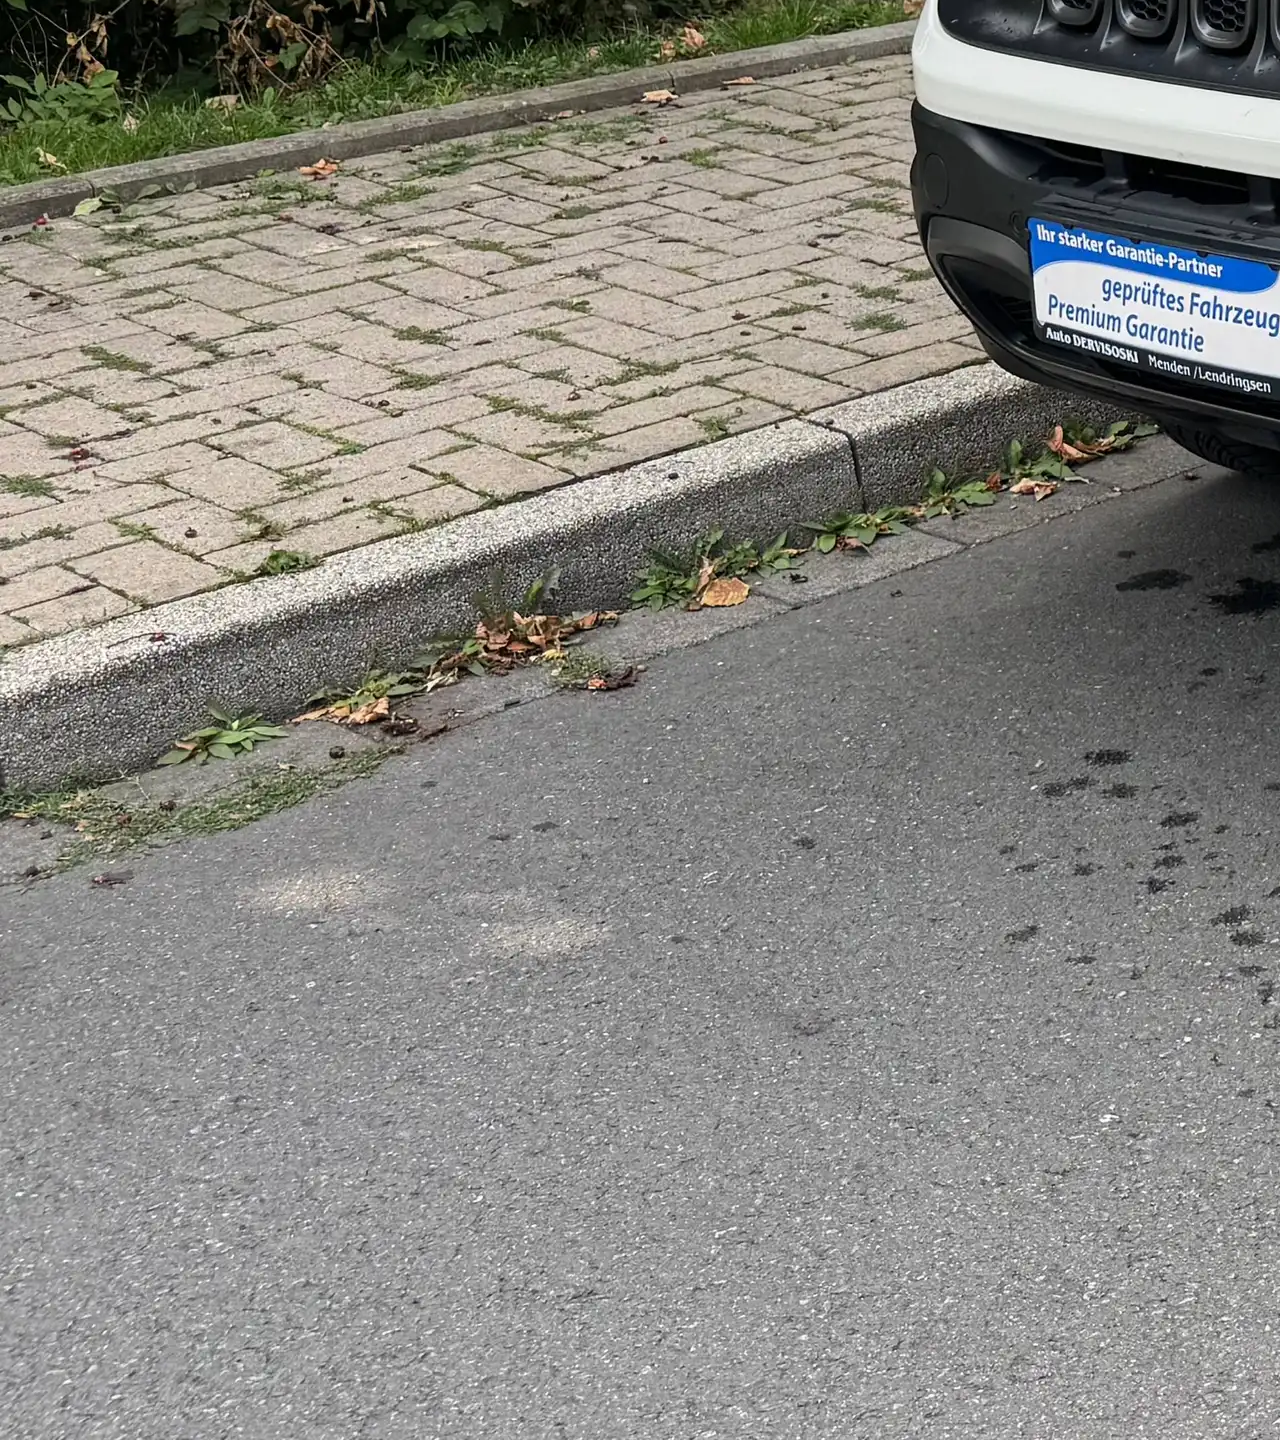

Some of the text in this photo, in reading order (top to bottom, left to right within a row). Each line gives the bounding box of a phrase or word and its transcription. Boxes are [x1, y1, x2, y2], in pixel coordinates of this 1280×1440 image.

[1036, 224, 1224, 278] Ihr starker Garantie-Partner
[1048, 294, 1204, 352] Premium Garantie
[1102, 279, 1280, 337] geprüftes Fahrzeug
[1046, 327, 1071, 344] Auto
[1073, 334, 1139, 364] DERVISOSKI
[1148, 354, 1191, 376] Menden
